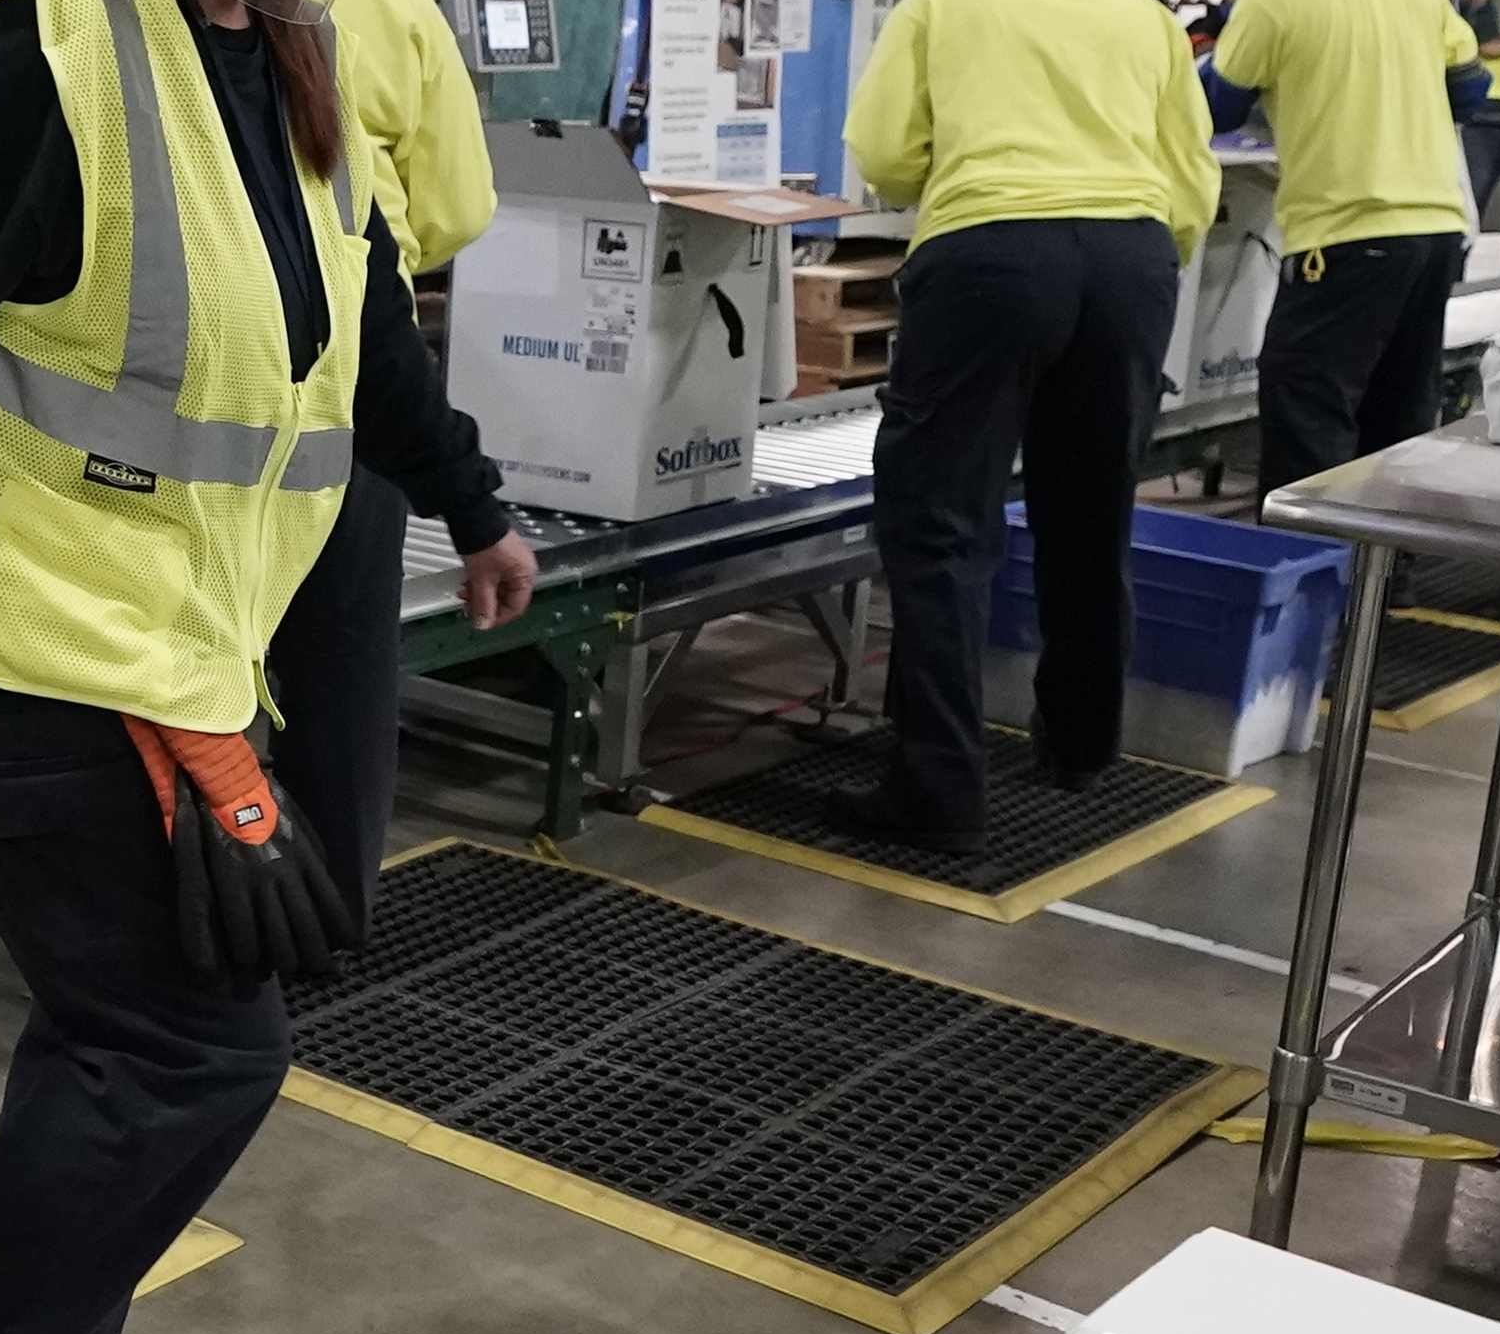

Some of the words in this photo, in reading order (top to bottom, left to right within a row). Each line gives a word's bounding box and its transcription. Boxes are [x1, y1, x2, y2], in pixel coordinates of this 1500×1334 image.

[502, 333, 560, 360] MEDIUM
[563, 341, 584, 364] UL
[655, 435, 742, 477] Softbox
